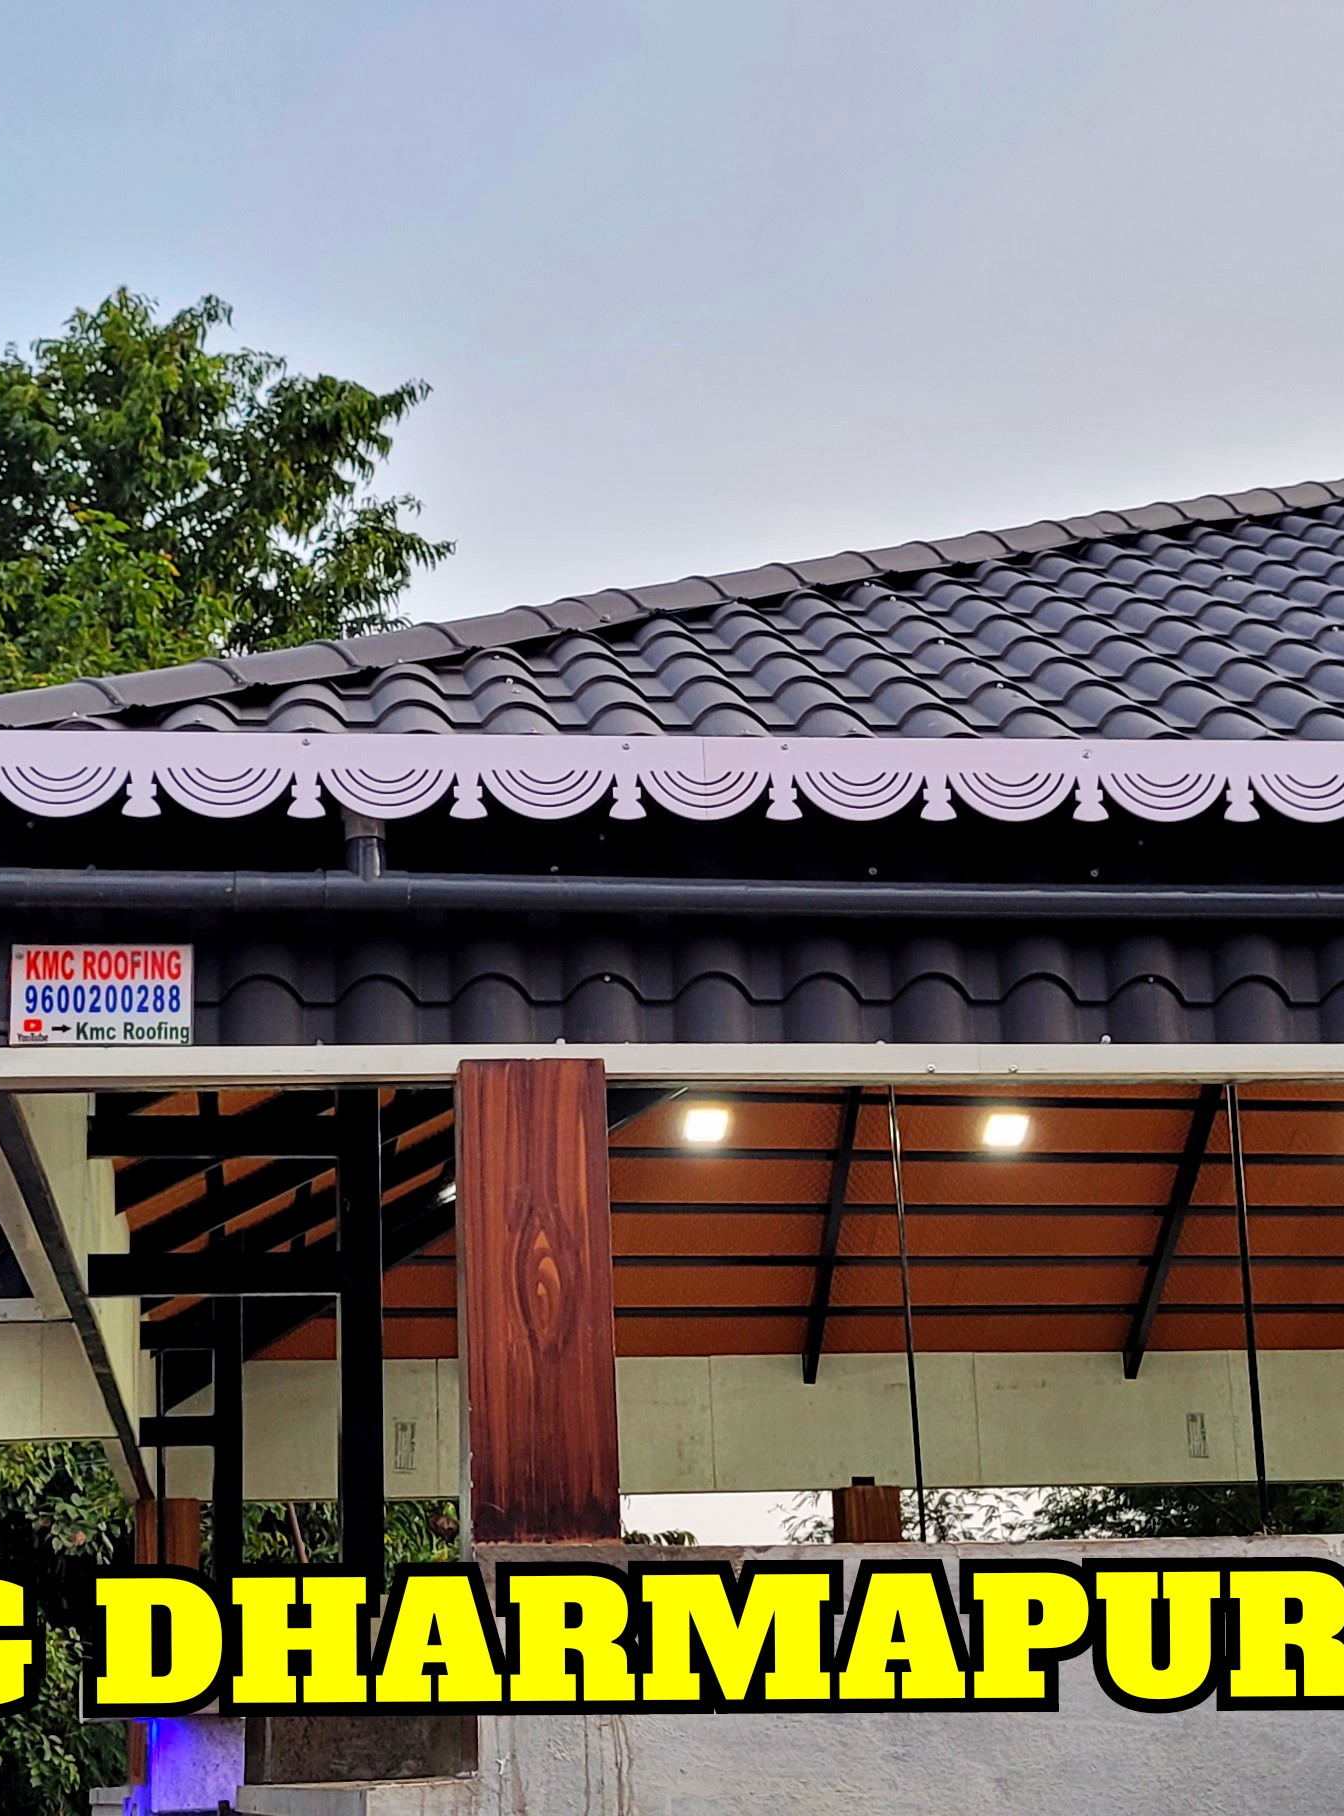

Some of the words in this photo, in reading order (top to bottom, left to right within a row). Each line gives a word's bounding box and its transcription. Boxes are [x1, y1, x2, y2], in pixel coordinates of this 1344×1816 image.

[25, 950, 74, 980] KMC
[83, 950, 182, 980] ROOFING
[25, 984, 181, 1013] 9600200288
[76, 1022, 116, 1041] Kmc
[123, 1022, 190, 1044] Roofing
